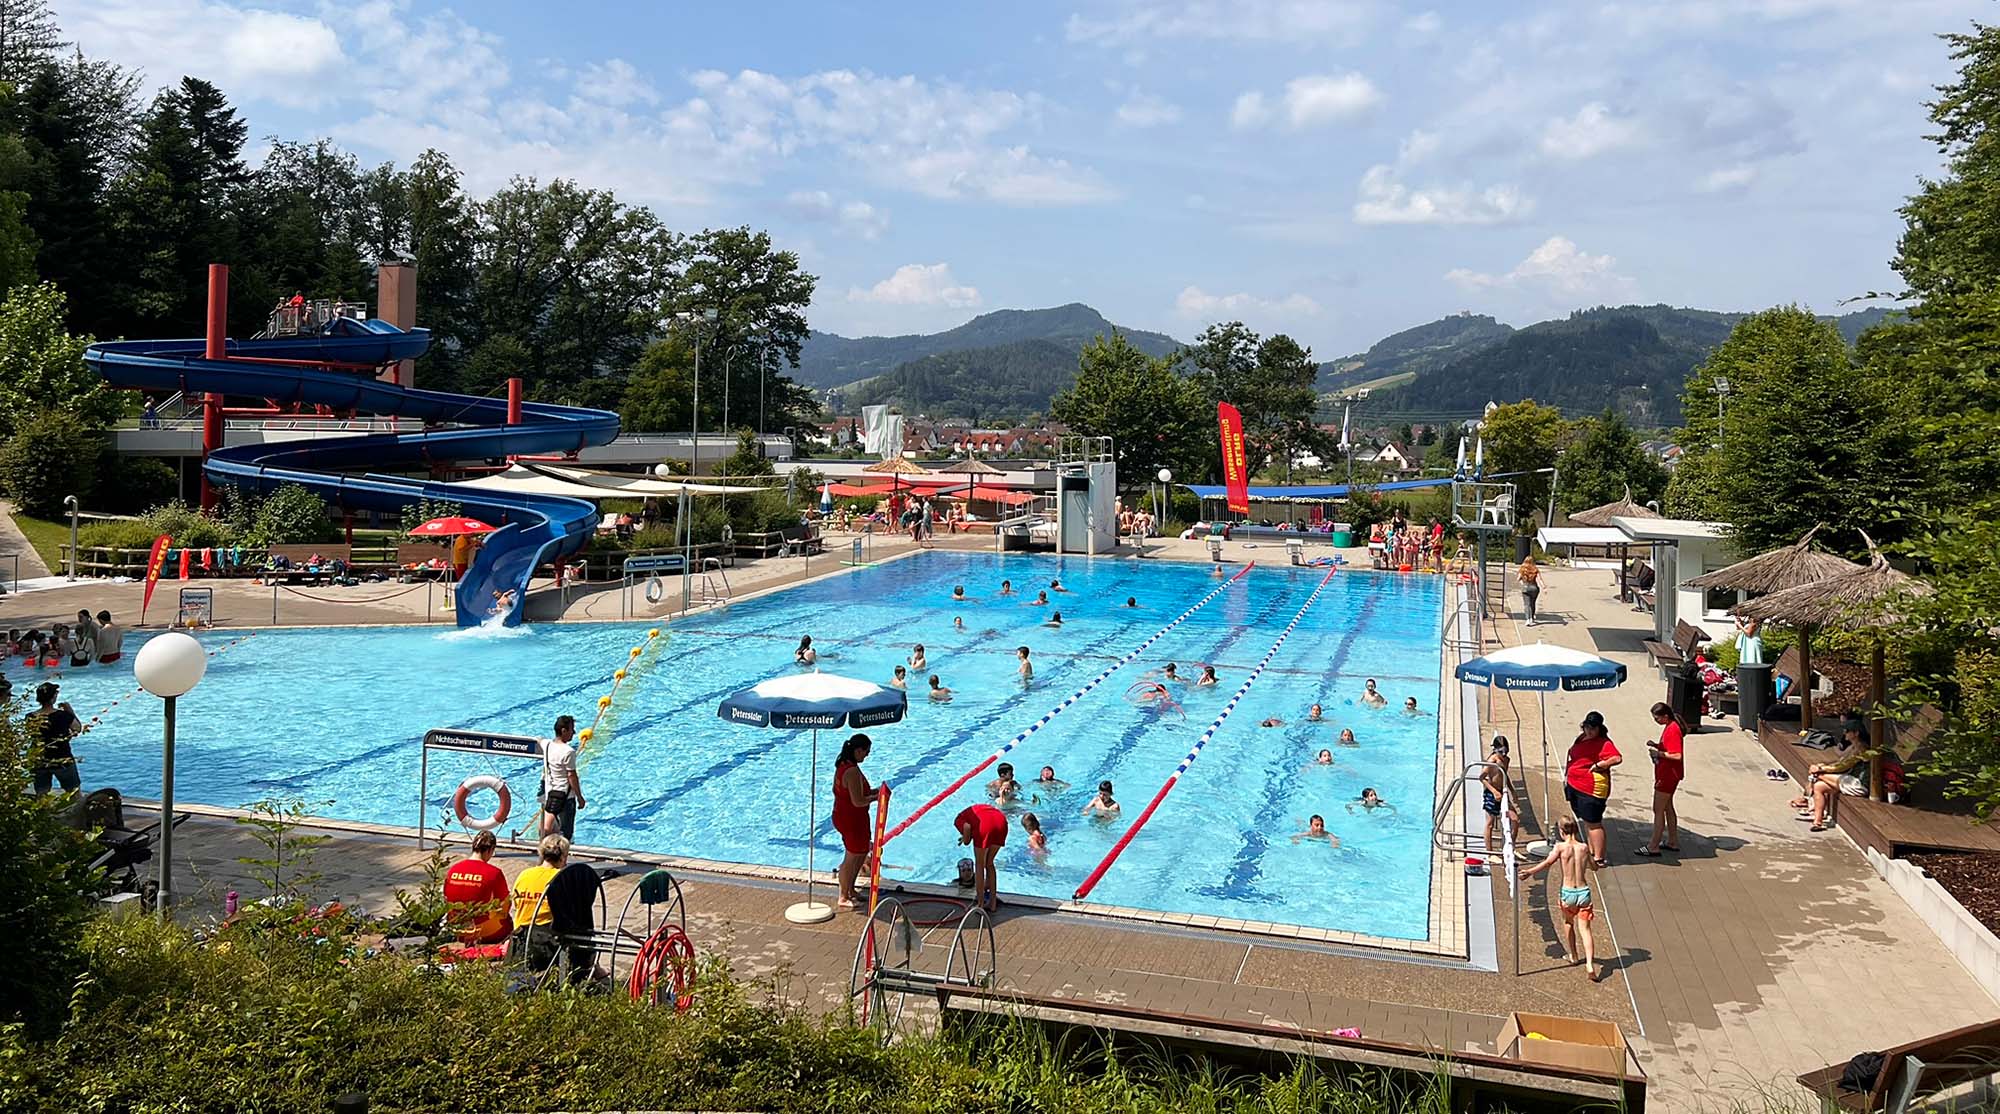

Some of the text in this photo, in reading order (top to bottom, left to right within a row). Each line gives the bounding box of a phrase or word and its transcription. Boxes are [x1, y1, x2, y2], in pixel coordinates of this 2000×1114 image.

[1505, 677, 1549, 688] Peterstaler
[1570, 677, 1606, 689] Peterstaler
[731, 707, 763, 722] Peterstaler
[784, 714, 835, 726] Peterstaler
[858, 710, 895, 724] Peterstaler
[435, 734, 482, 746] Nichtschwimmer
[492, 740, 529, 751] Schwimmer
[450, 872, 483, 882] DLRG
